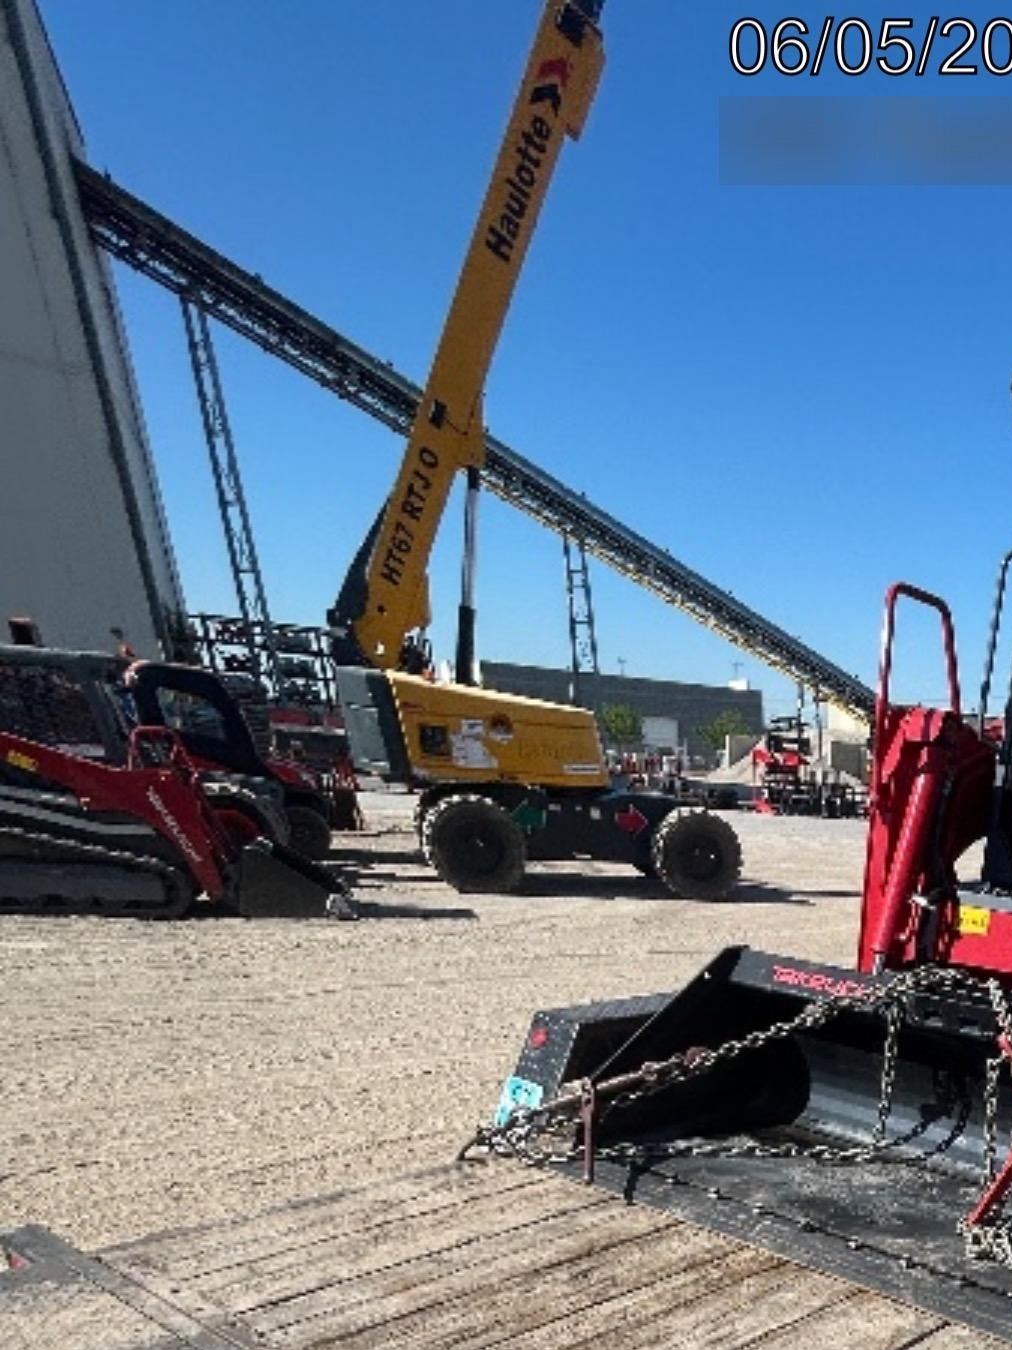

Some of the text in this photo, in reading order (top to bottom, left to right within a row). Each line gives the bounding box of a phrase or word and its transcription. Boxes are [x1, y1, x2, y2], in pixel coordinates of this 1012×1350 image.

[485, 116, 552, 262] Haulotte
[380, 520, 415, 586] HT67
[401, 471, 433, 523] RTJ
